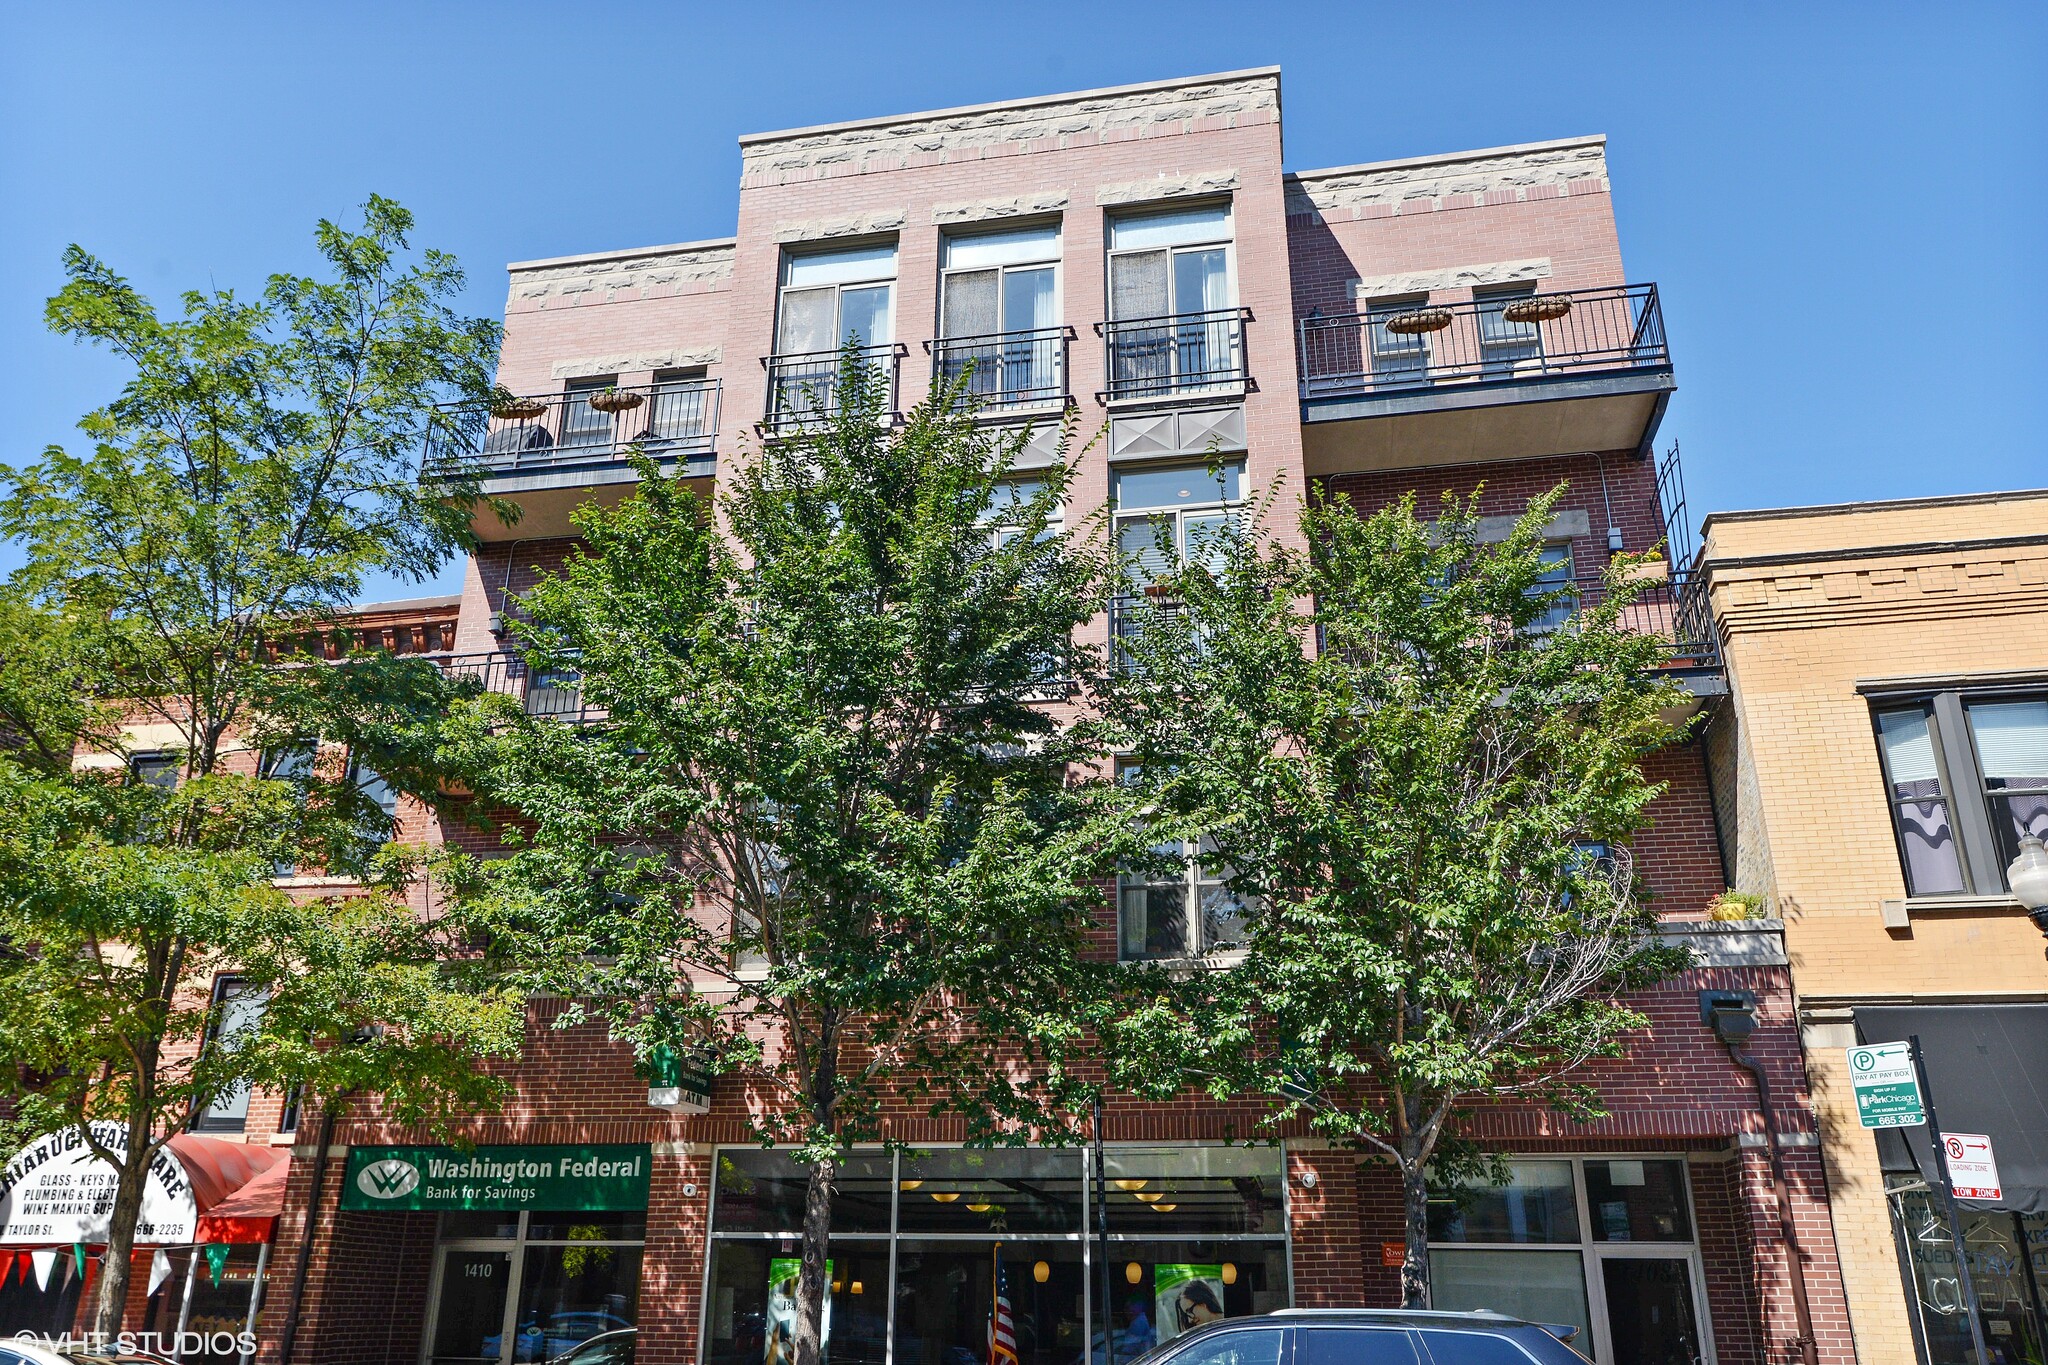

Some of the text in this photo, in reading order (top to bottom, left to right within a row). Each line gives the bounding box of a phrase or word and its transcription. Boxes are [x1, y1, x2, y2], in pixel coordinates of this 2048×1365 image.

[1870, 1072, 1877, 1080] AT
[1869, 1093, 1916, 1104] ParkChicago
[1878, 1116, 1897, 1125] 665
[1898, 1114, 1917, 1123] 302
[427, 1155, 641, 1183] Washington Federal
[40, 1174, 72, 1186] GLASS
[80, 1174, 105, 1186] KEYS
[24, 1188, 116, 1201] PLUMBING & ELECT
[426, 1184, 536, 1201] Bank for Savings
[1955, 1188, 1996, 1198] TOW ZONE
[23, 1203, 49, 1215] WINE
[50, 1203, 91, 1215] MAKING
[8, 1224, 40, 1236] TAYLOR
[42, 1224, 54, 1236] St.
[1914, 1250, 1975, 1265] SUEDS
[464, 1263, 492, 1278] 1410
